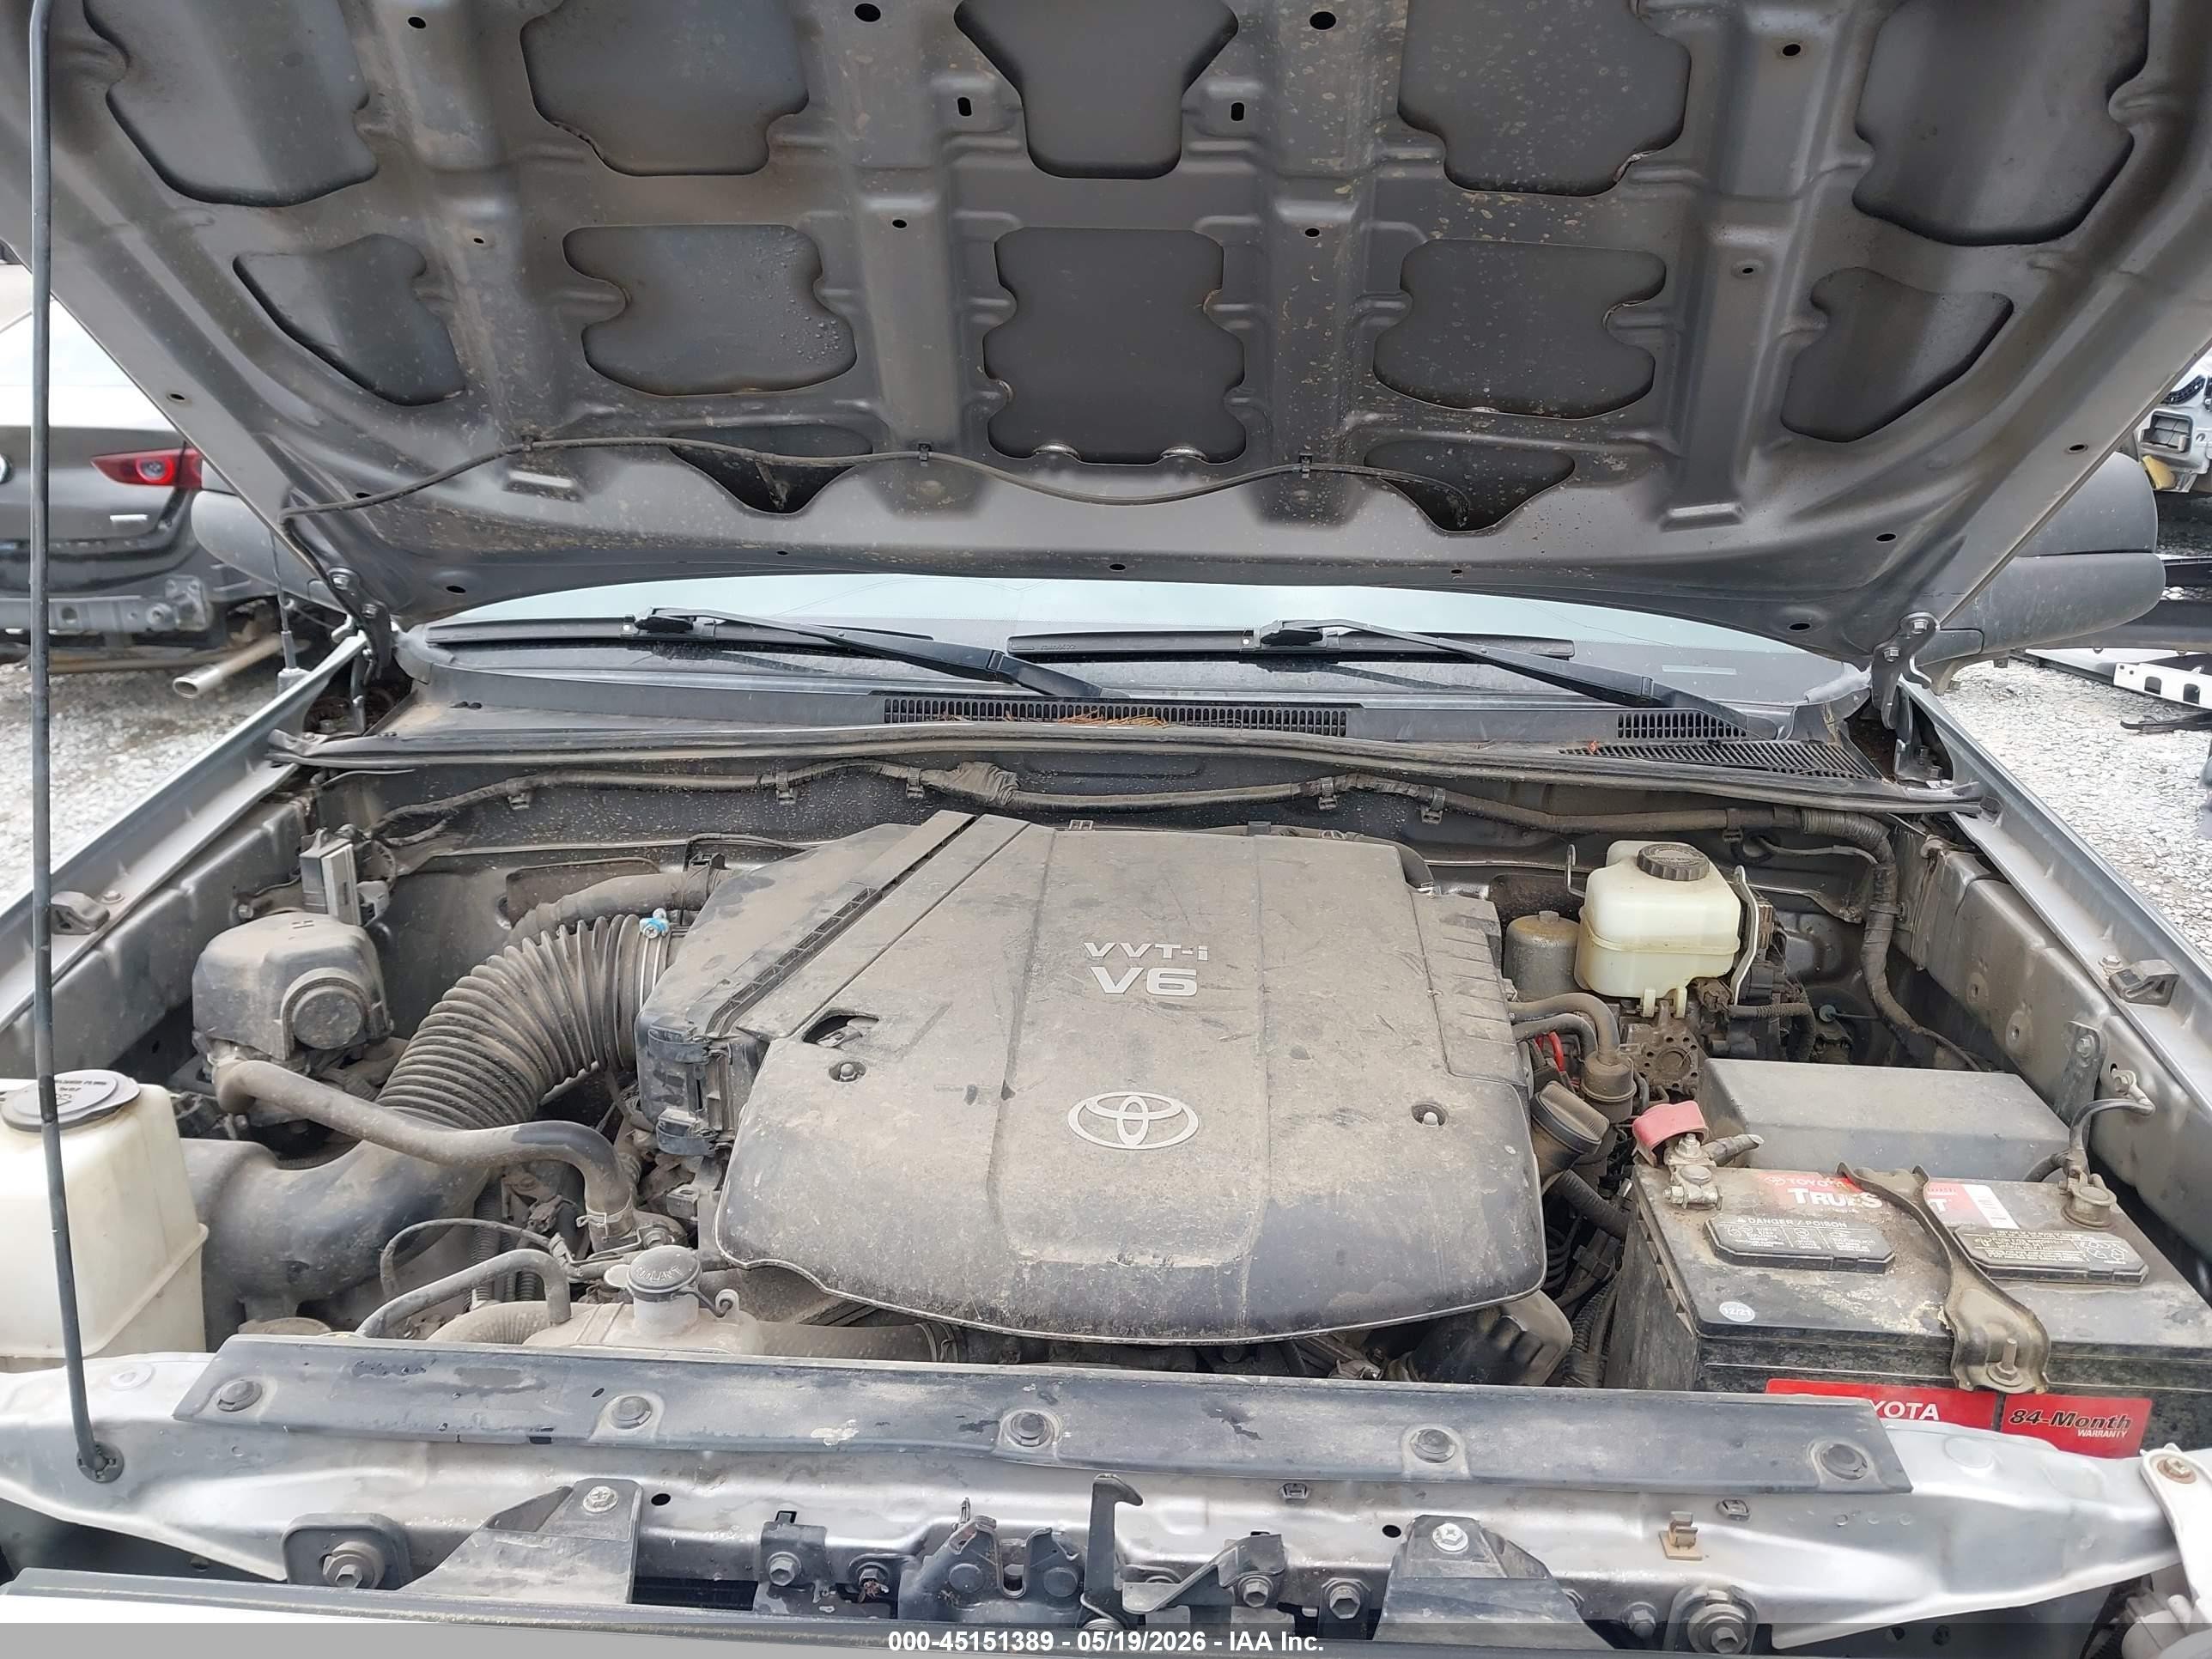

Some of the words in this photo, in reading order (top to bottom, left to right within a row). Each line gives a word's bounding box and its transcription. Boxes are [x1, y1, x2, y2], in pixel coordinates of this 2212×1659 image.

[1084, 942, 1208, 961] VVT-i
[1091, 967, 1197, 996] V6
[1747, 1217, 1794, 1226] DANGER
[1805, 1219, 1848, 1228] POISON
[635, 1265, 682, 1281] COOLANT
[2008, 1407, 2131, 1431] 84-Month
[2077, 1429, 2128, 1438] WARRANTY
